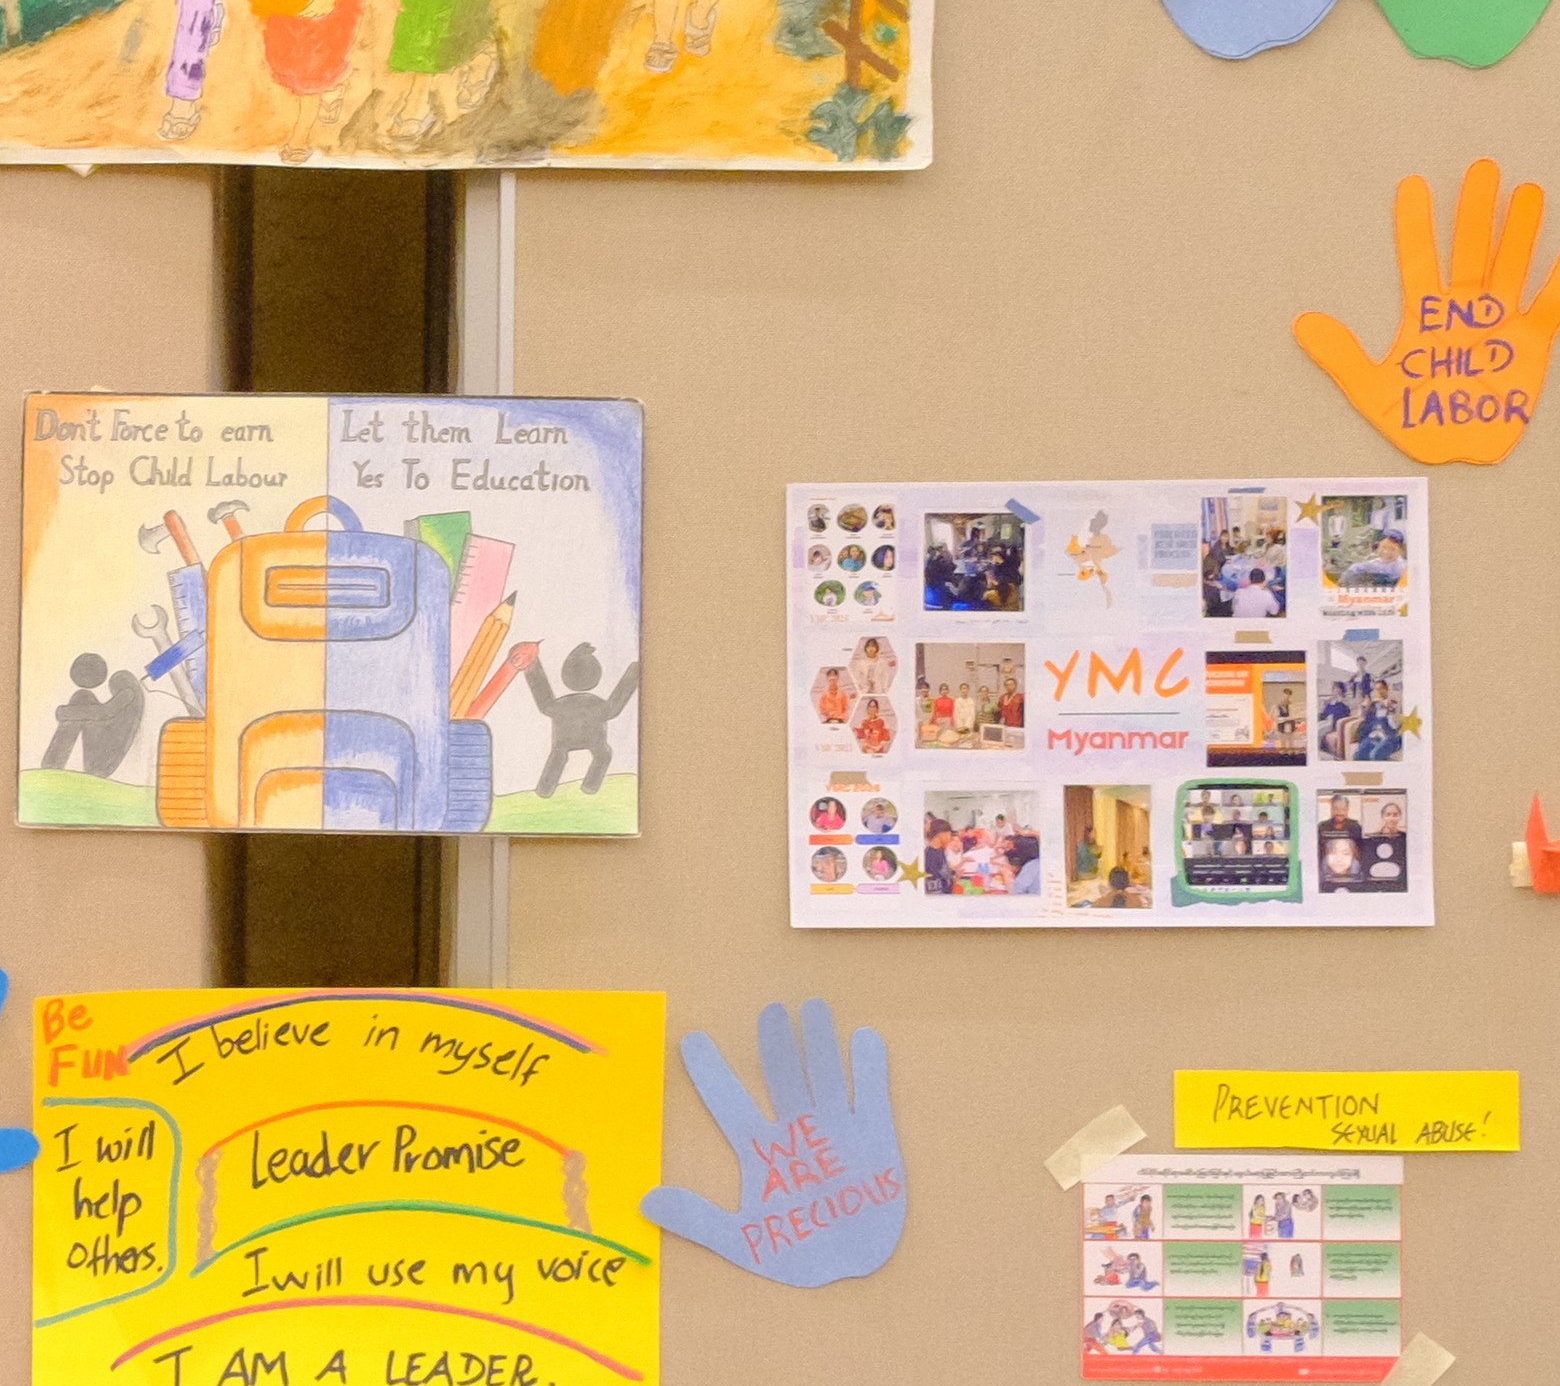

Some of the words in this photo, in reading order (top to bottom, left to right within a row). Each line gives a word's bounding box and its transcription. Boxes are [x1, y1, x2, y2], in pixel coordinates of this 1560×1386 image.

[1419, 293, 1505, 333] END
[1400, 339, 1514, 379] CHILD
[110, 410, 168, 443] Force
[176, 413, 203, 443] to
[220, 421, 274, 444] earn
[339, 410, 385, 444] Let
[403, 411, 473, 445] them
[494, 411, 569, 445] Learn
[1401, 386, 1531, 429] LABOR
[59, 455, 115, 495] Stop
[129, 455, 193, 489] Child
[204, 456, 288, 490] Labour
[351, 459, 384, 490] Yes
[402, 459, 431, 491] To
[450, 458, 592, 492] Education
[1043, 647, 1192, 703] YMC
[1047, 728, 1190, 757] Myanmar
[48, 1044, 131, 1087] FUN
[156, 1037, 206, 1086] I
[209, 1016, 331, 1057] believe
[364, 1012, 401, 1051] in
[421, 1032, 551, 1087] myself
[1212, 1082, 1380, 1123] PREVENTION
[53, 1123, 82, 1173] I
[96, 1120, 158, 1162] will
[391, 1123, 525, 1174] Promise
[752, 1113, 830, 1168] WE
[1330, 1121, 1398, 1146] SEXUAL
[760, 1147, 847, 1204] ARE
[73, 1177, 144, 1238] help
[739, 1166, 902, 1266] PRECIOUS
[241, 1246, 269, 1298] I
[270, 1255, 344, 1294] will
[367, 1258, 426, 1288] use
[452, 1262, 519, 1305] my
[536, 1255, 627, 1290] voice
[313, 1349, 348, 1384] A
